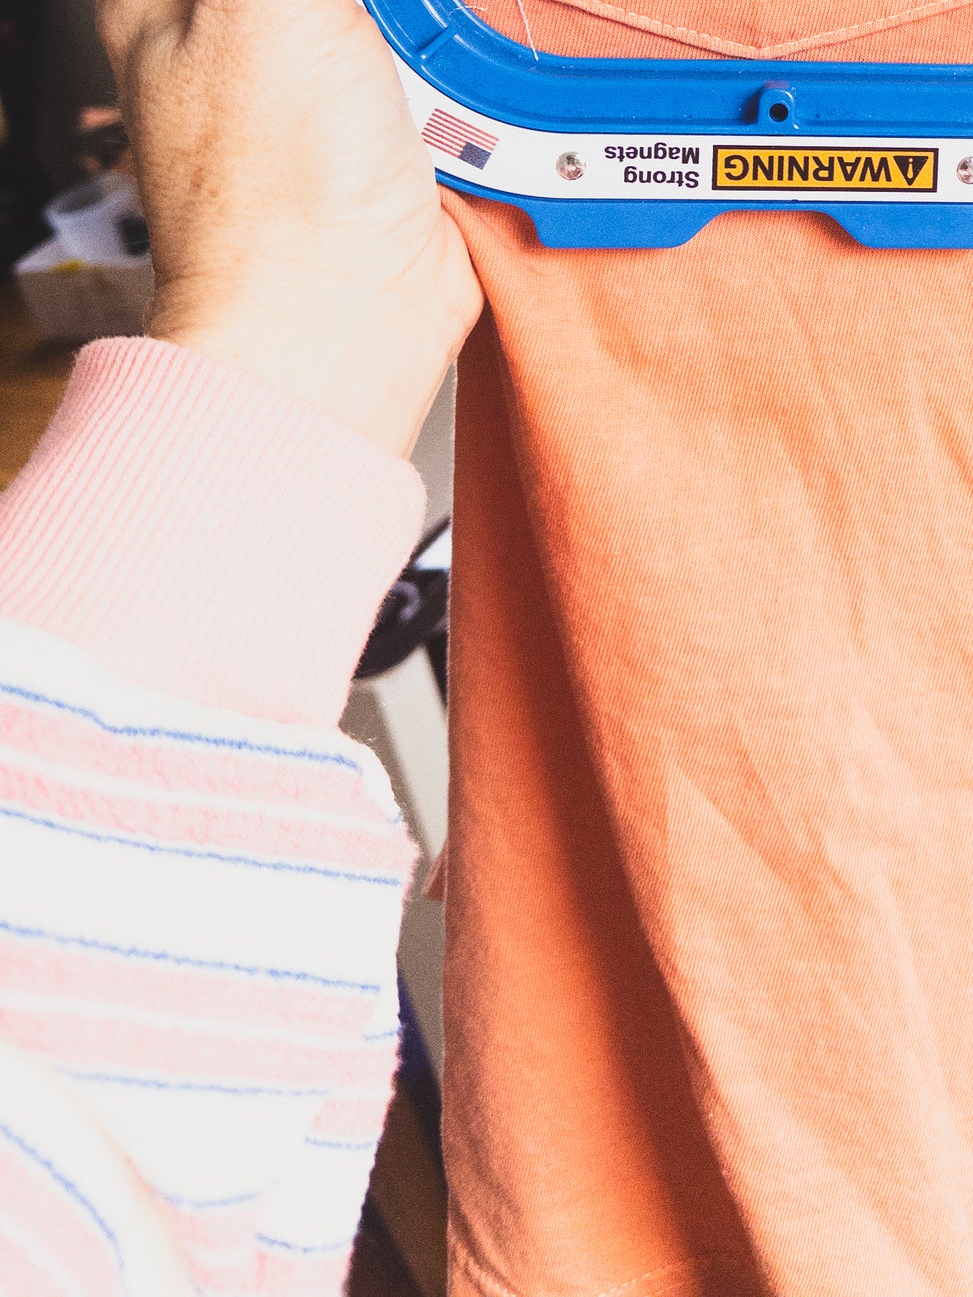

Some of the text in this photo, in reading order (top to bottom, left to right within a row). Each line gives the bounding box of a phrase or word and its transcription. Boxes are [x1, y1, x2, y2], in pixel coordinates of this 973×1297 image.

[604, 145, 700, 165] Magnets
[623, 166, 700, 189] Strong
[724, 154, 892, 182] WARNING
